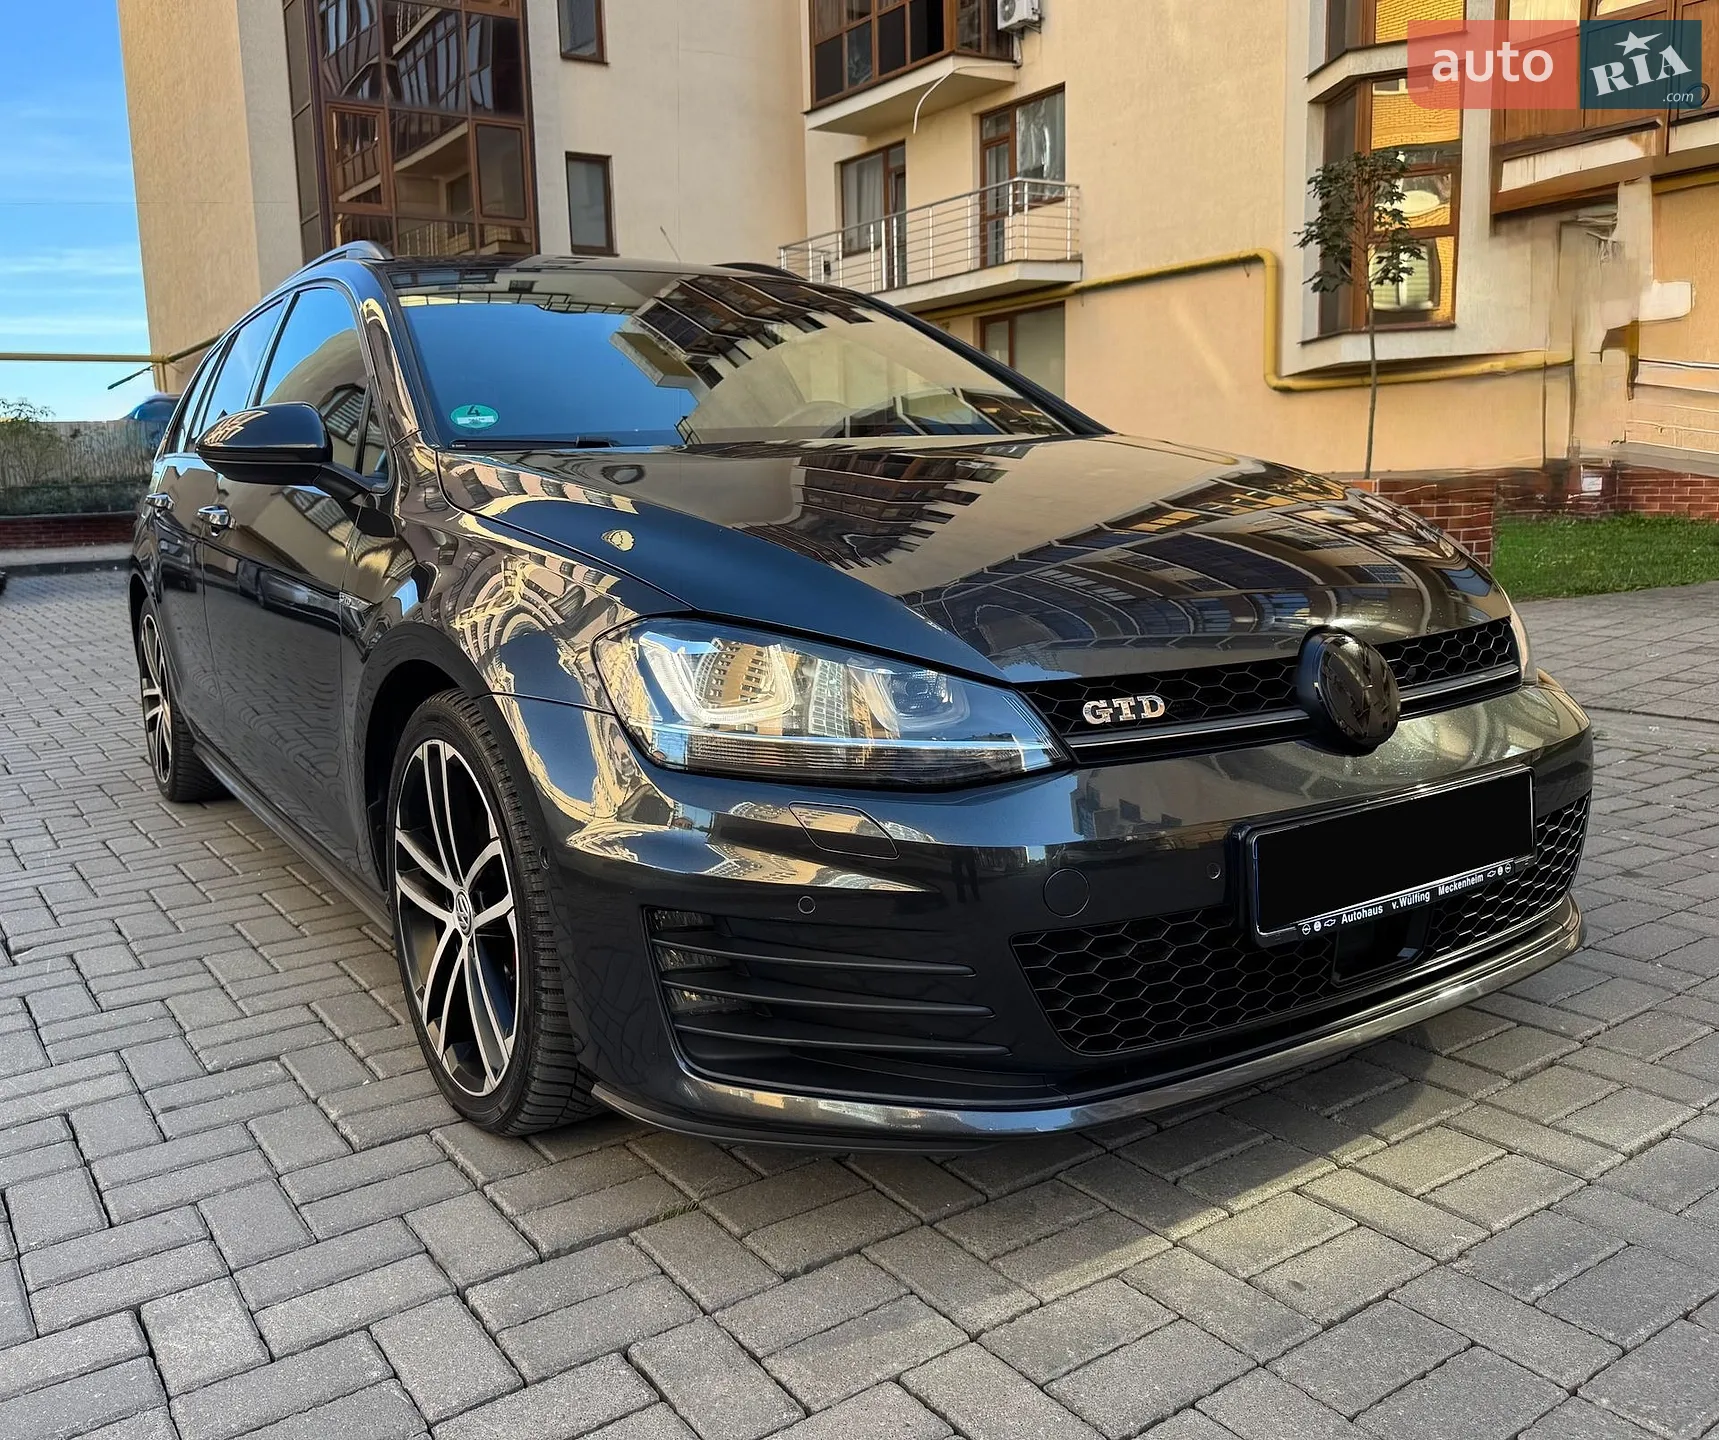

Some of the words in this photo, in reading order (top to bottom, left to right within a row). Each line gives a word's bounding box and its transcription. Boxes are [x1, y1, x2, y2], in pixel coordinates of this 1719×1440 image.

[1082, 694, 1165, 725] GTD
[1341, 905, 1383, 924] Autohaus
[1438, 873, 1484, 896] Meckenheim
